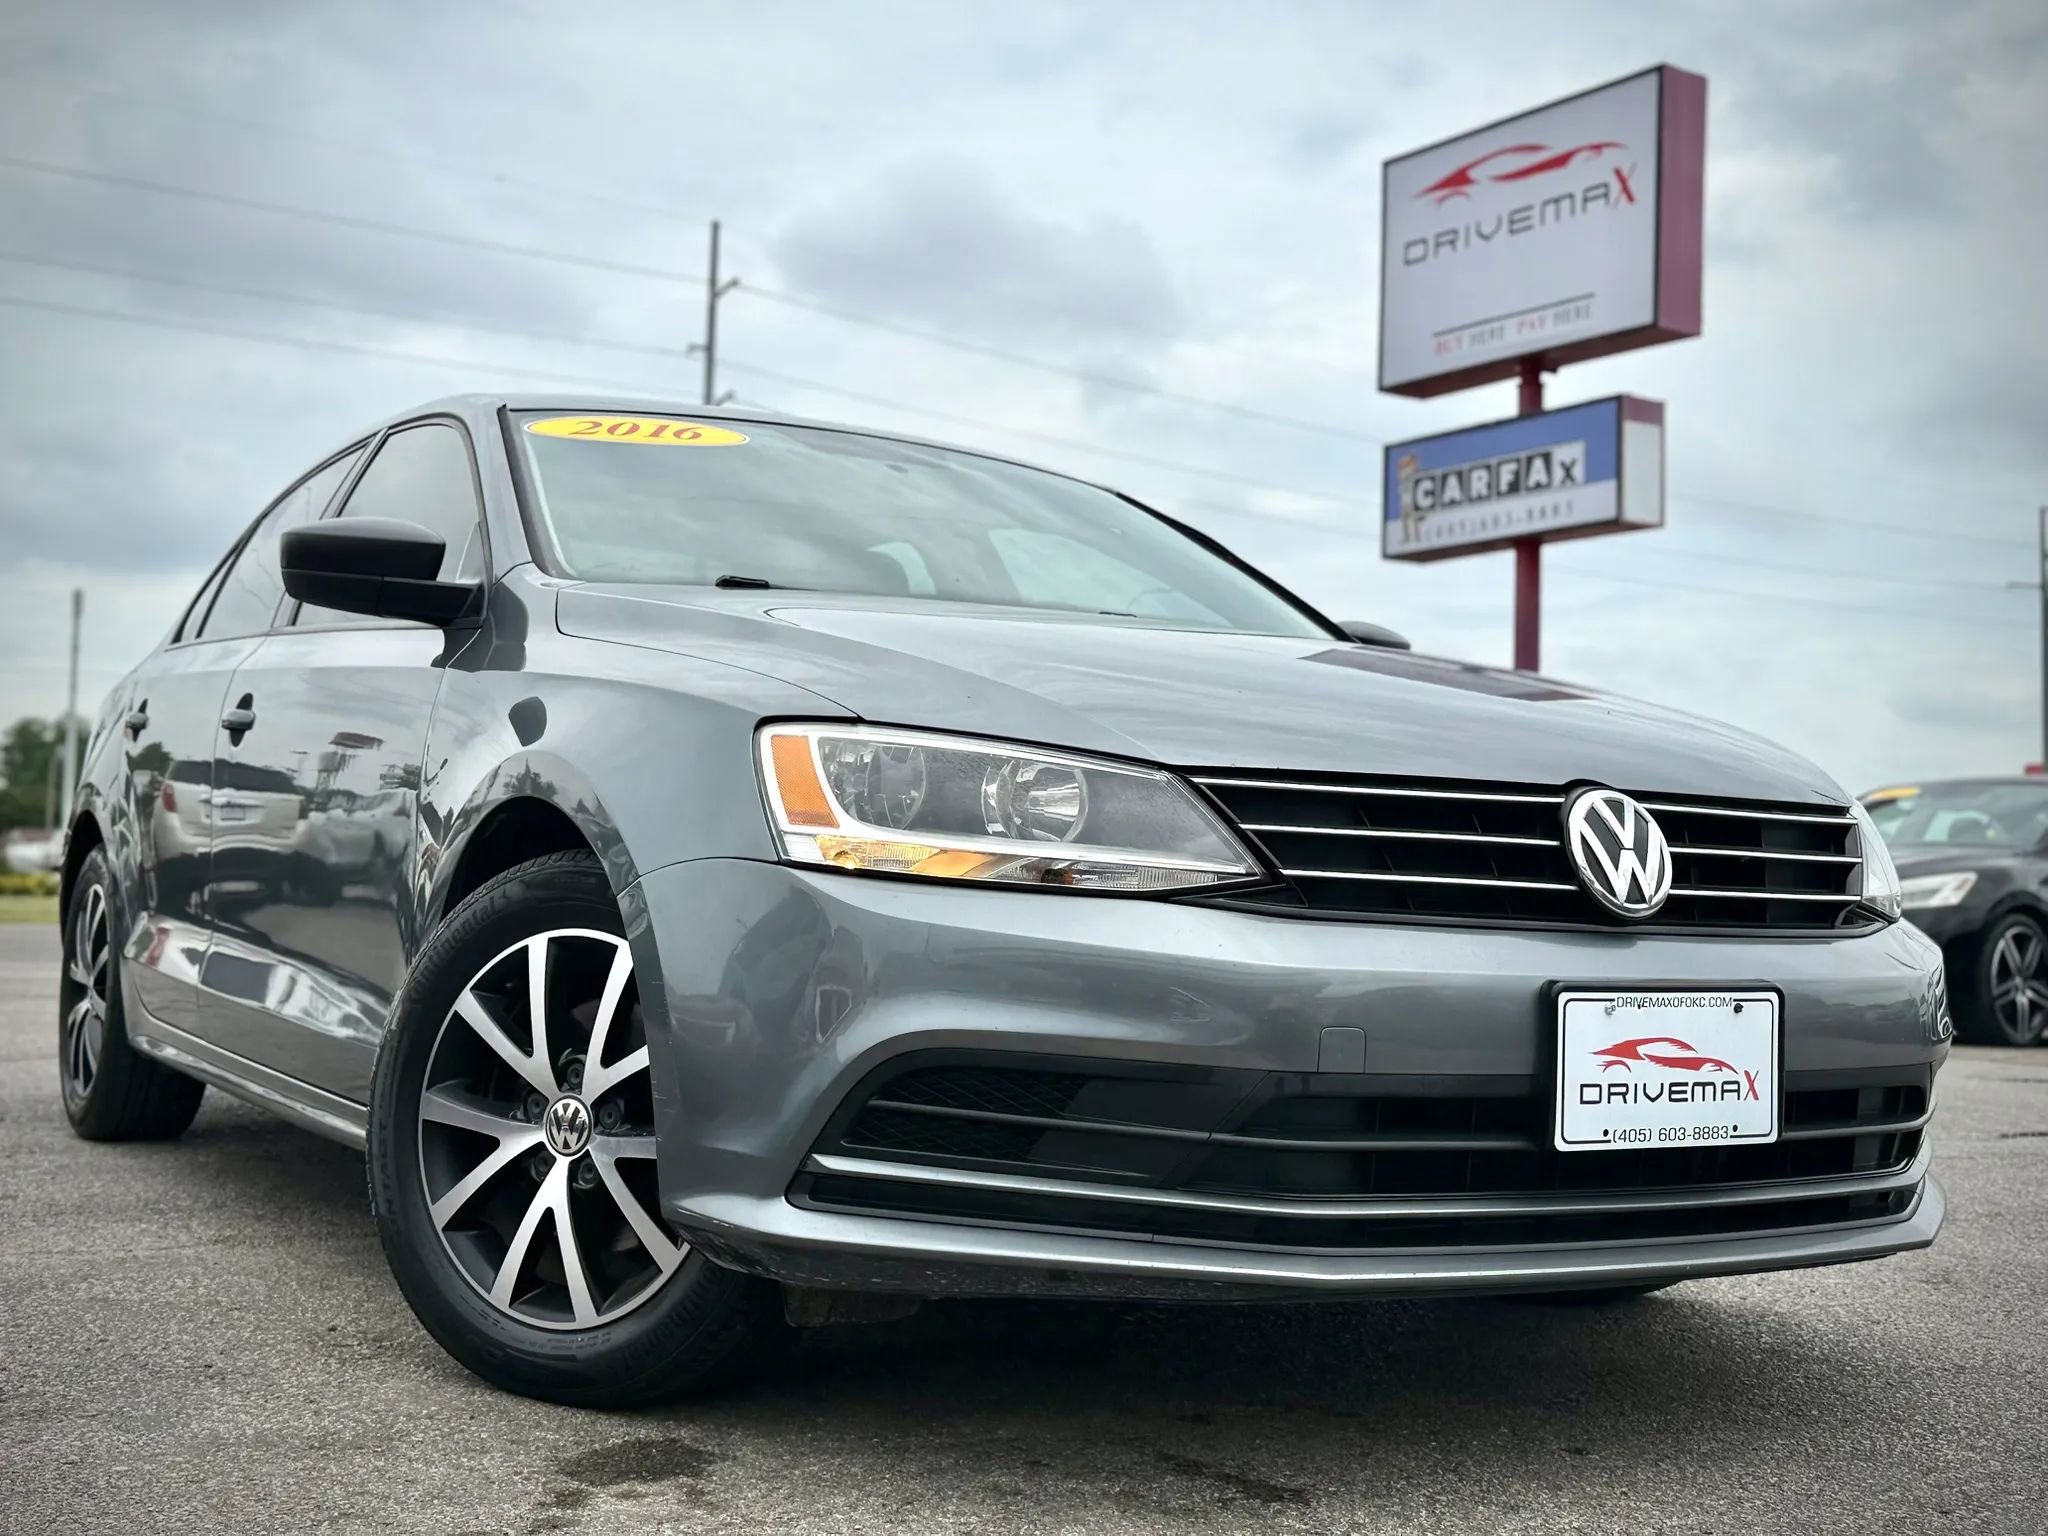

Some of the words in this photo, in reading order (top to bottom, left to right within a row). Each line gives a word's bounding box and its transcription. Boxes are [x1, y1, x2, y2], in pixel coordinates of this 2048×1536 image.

[1402, 162, 1638, 268] DRIVEMAX
[567, 420, 703, 441] 2016
[1413, 452, 1579, 511] CARFAX
[1616, 996, 1733, 1009] DRIVEMAXOFOKC.COM
[1579, 1069, 1760, 1105] DRIVEMAX
[1612, 1128, 1652, 1144] (405)
[1657, 1125, 1730, 1142] 603-8883
